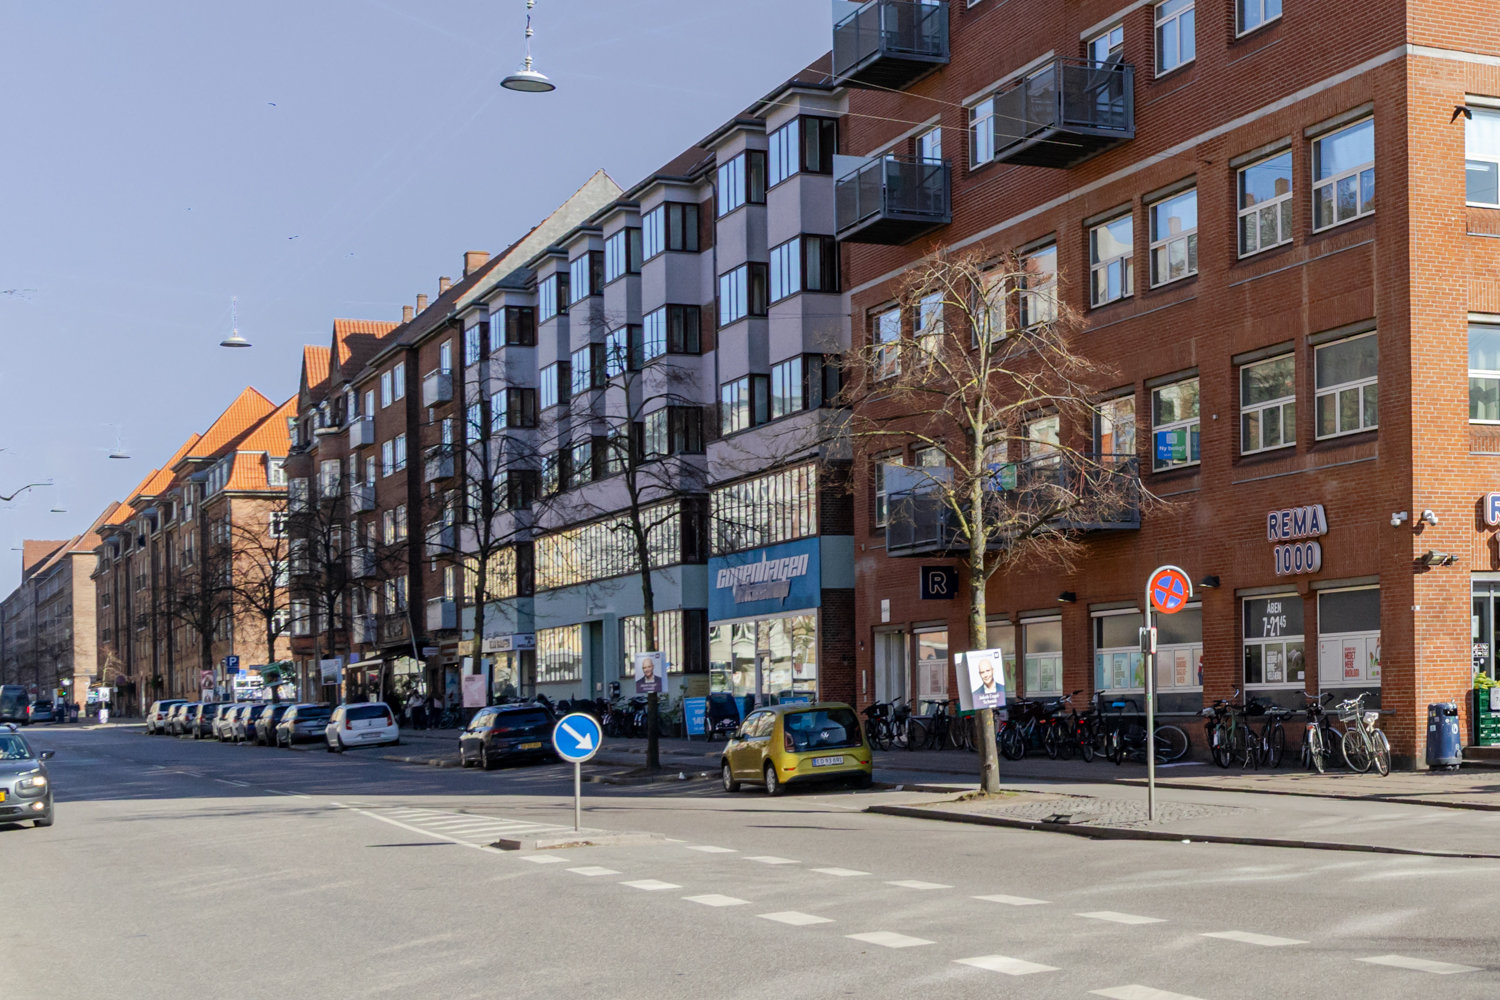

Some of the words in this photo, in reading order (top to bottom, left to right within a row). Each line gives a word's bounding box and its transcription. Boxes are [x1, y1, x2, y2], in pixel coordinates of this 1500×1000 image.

[1267, 505, 1324, 542] REMA
[1274, 542, 1320, 576] 1000
[929, 571, 947, 594] R
[1267, 600, 1282, 613] ÅBEN
